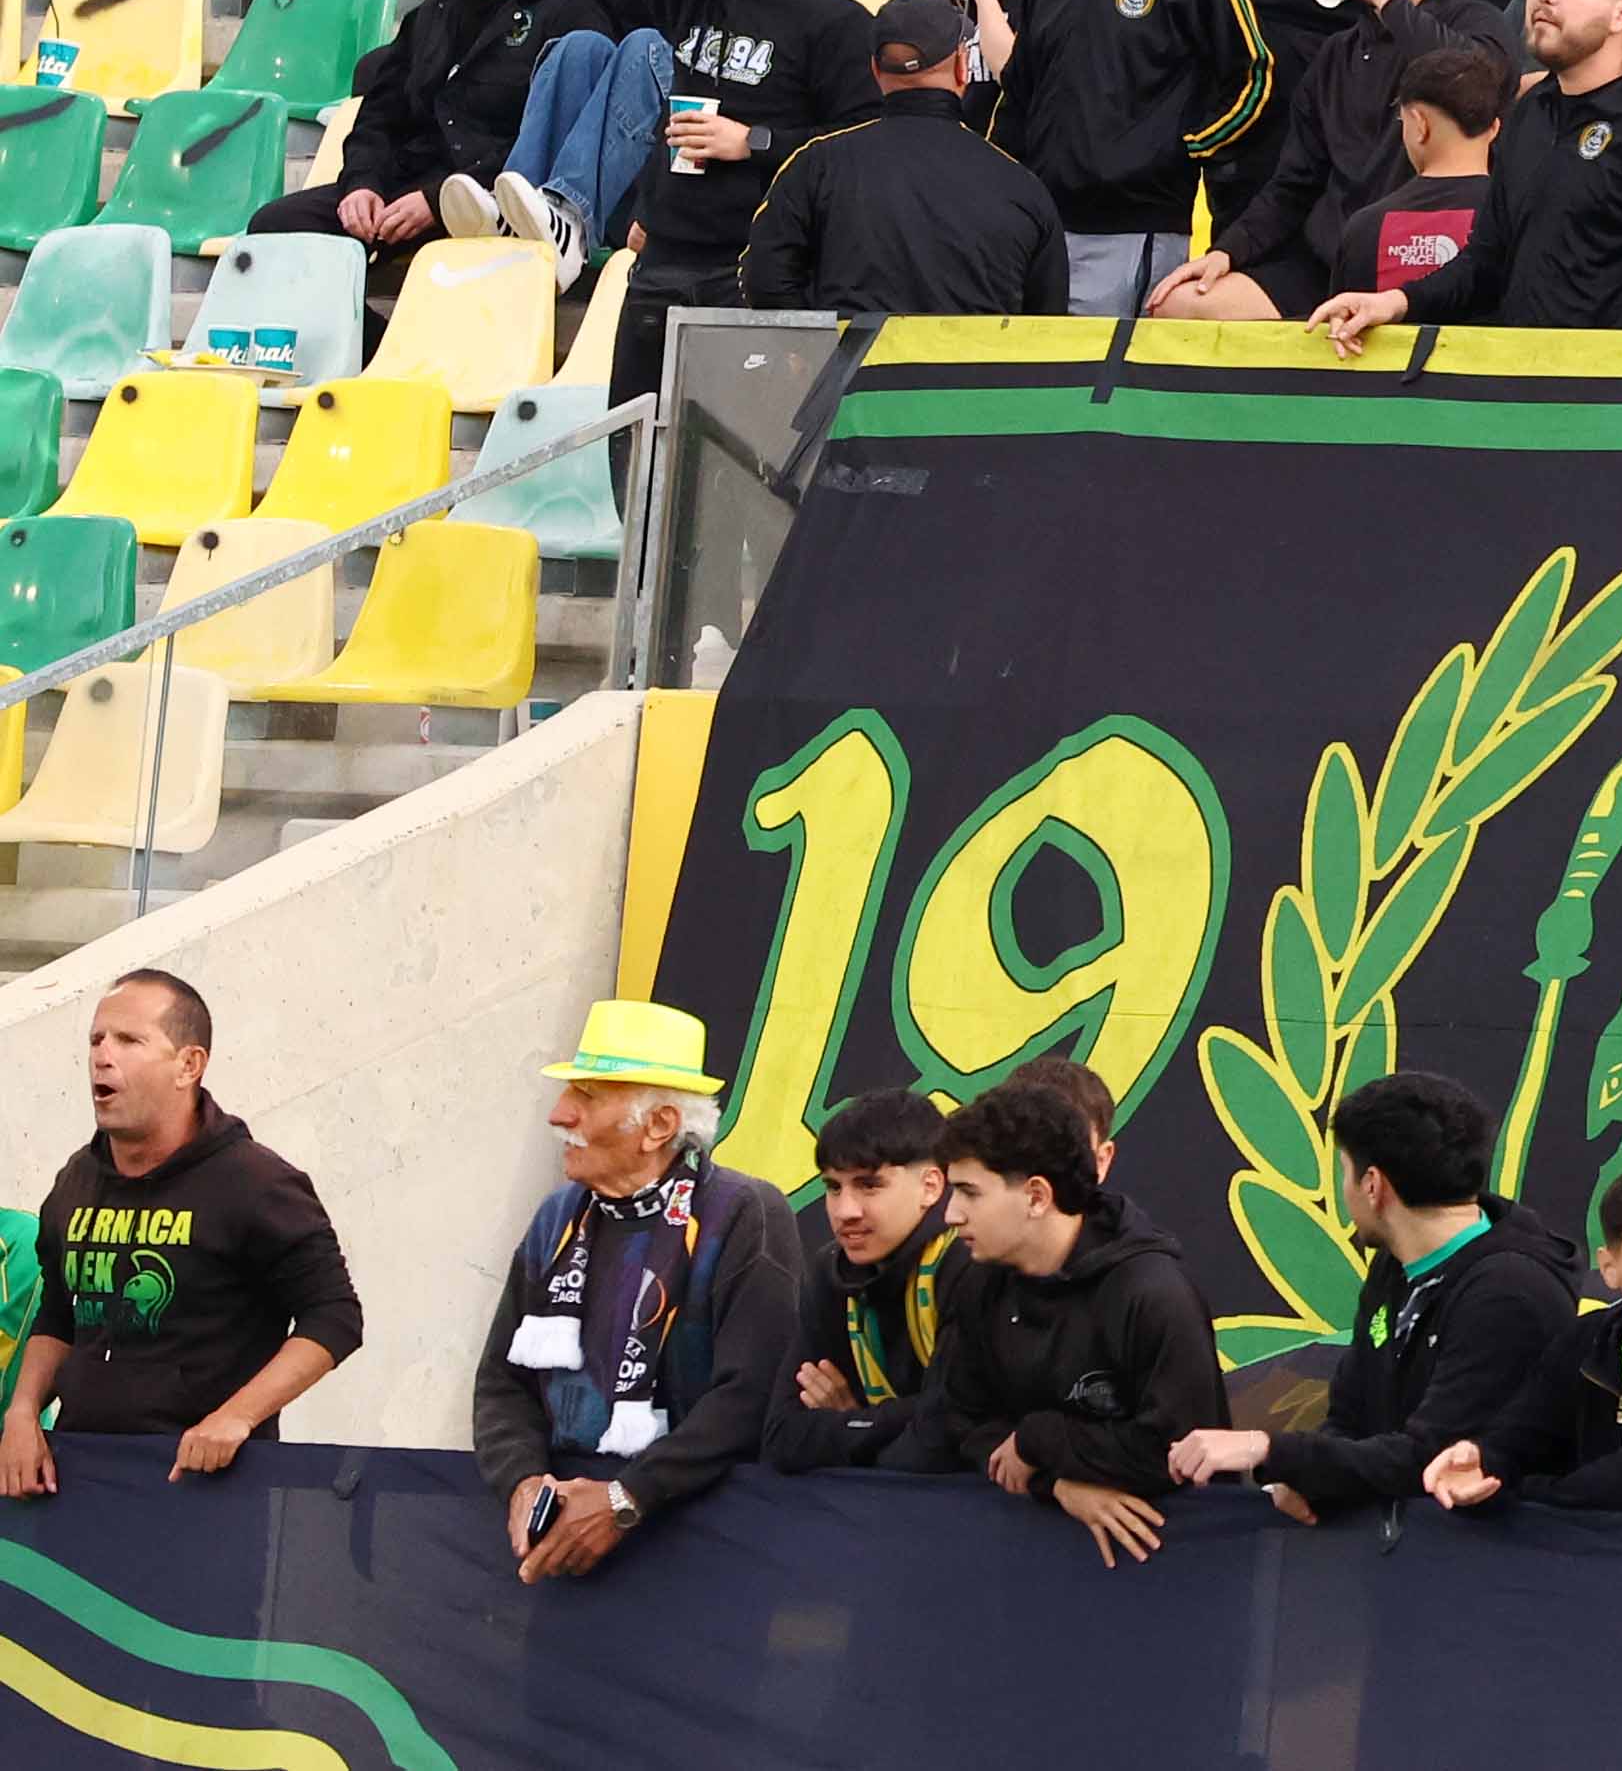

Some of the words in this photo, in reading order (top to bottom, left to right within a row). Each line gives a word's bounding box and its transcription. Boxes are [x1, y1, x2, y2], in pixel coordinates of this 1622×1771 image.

[1409, 235, 1436, 247] THE
[1387, 245, 1436, 258] NORTH
[1400, 255, 1436, 267] FACE
[712, 707, 1232, 1215] 19
